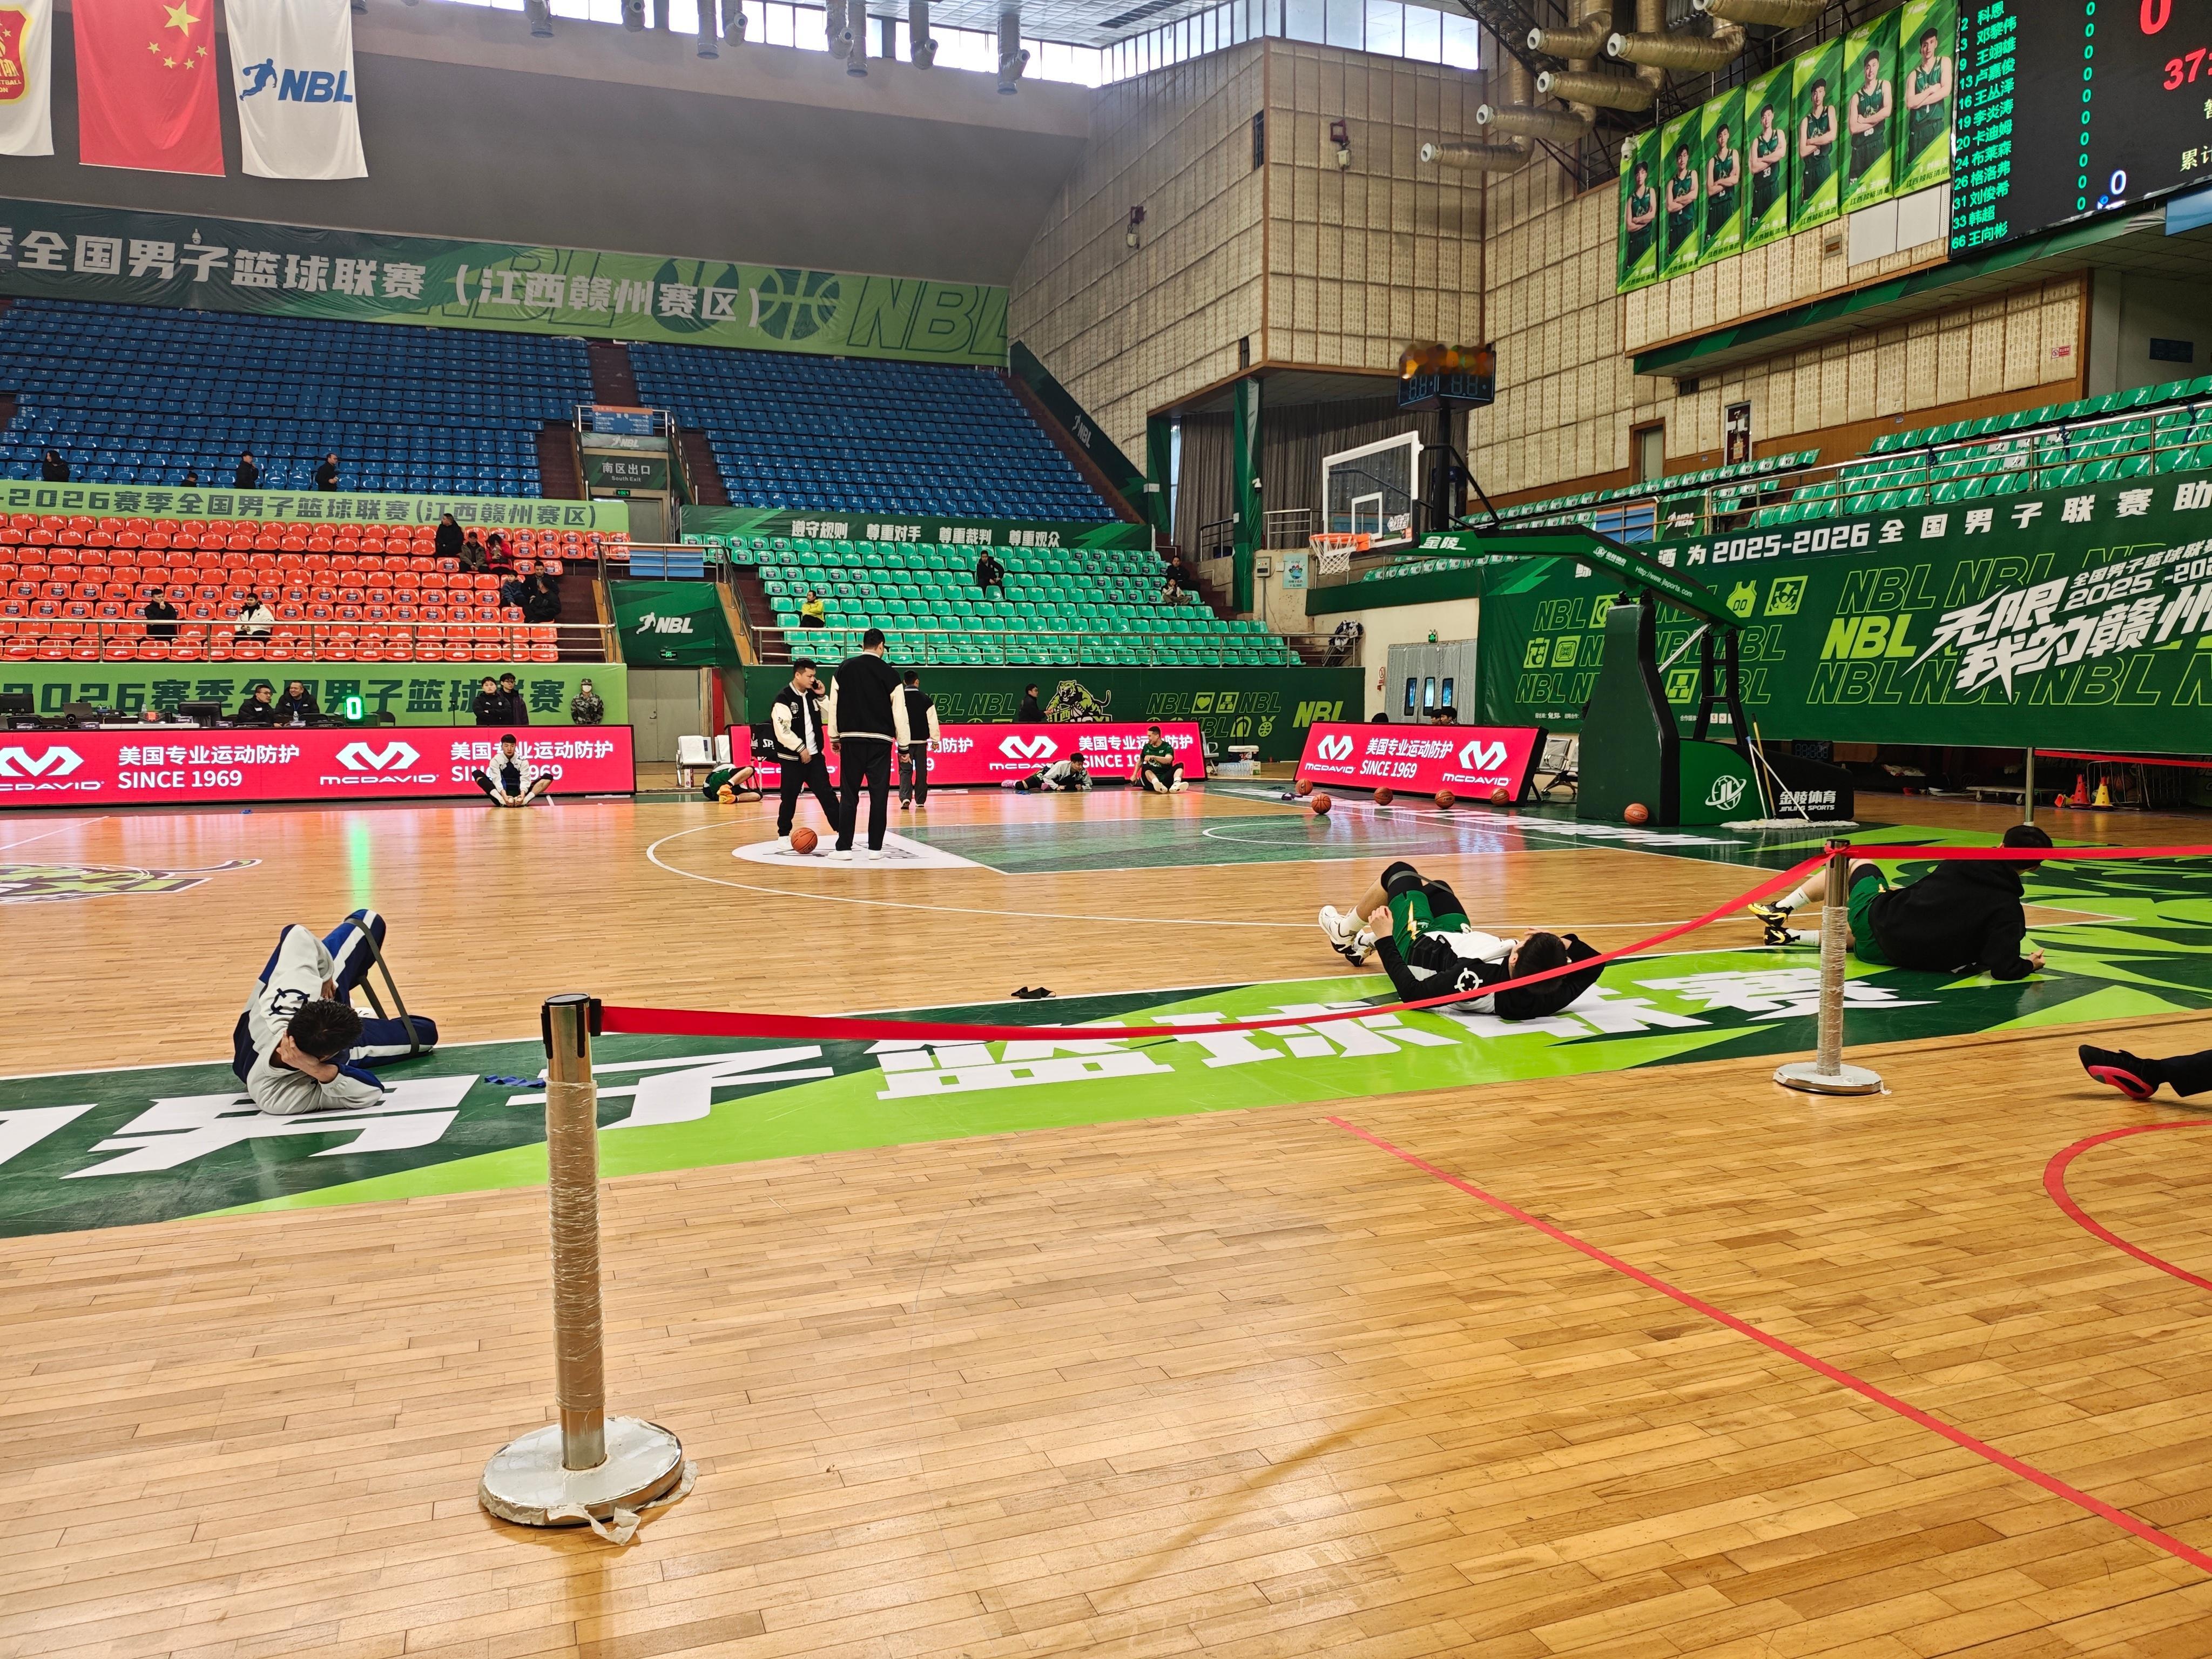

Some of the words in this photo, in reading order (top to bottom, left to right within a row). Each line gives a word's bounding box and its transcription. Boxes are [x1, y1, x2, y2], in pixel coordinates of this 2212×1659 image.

[2086, 1, 2095, 16] 0
[1961, 17, 1968, 31] 2
[2085, 23, 2094, 37] 0
[1960, 38, 1967, 51] 3
[2084, 45, 2093, 59] 0
[1959, 58, 1967, 71] 9
[2083, 67, 2093, 81] 0
[278, 69, 353, 103] NBL
[1959, 95, 1972, 110] 16
[1974, 77, 2014, 107] 王丛泽
[1960, 75, 1973, 90] 13
[2082, 89, 2092, 103] 0
[1958, 115, 1971, 130] 19
[2081, 110, 2090, 125] 0
[1956, 136, 1971, 151] 20
[1972, 119, 2013, 146] 卡迪姆
[2080, 132, 2089, 146] 0
[1955, 156, 1969, 171] 24
[1971, 140, 2012, 166] 布莱森
[2079, 153, 2088, 167] 0
[1954, 175, 1968, 190] 26
[1971, 160, 2011, 187] 格洛弗
[2078, 174, 2087, 189] 0
[2110, 169, 2127, 195] 0
[1954, 195, 1966, 210] 31
[1970, 180, 2010, 207] 刘俊希
[2077, 196, 2086, 211] 0
[1953, 215, 1967, 230] 33
[1969, 205, 1995, 227] 韩超
[1952, 234, 1966, 249] 66
[1968, 221, 2008, 247] 王向彬
[621, 438, 639, 448] NBL
[602, 462, 651, 475] 南区出口
[791, 520, 848, 539] 遵守规则
[866, 523, 921, 542] 尊重对手
[939, 527, 992, 545] 尊重裁判
[1008, 529, 1061, 548] 尊重观众
[1837, 563, 1937, 615] NBL
[655, 617, 693, 633] NBL
[1533, 597, 1587, 632] NBL
[1820, 613, 1917, 660] NBL
[1900, 577, 2069, 678] 无限
[1807, 659, 1904, 705] NBL
[346, 696, 362, 720] 0
[968, 693, 1016, 716] NBL
[1146, 692, 1190, 714] NBL
[1238, 691, 1282, 713] NBL
[1292, 700, 1347, 728] NBL
[118, 744, 300, 766] 美国专业运动防护
[1366, 738, 1454, 760] 美国专业运动防护
[117, 770, 185, 790] SINCE
[191, 769, 243, 787] 1969
[1359, 759, 1391, 776] SINCE
[1391, 762, 1417, 779] 1969
[1779, 790, 1837, 806] 金陵体育
